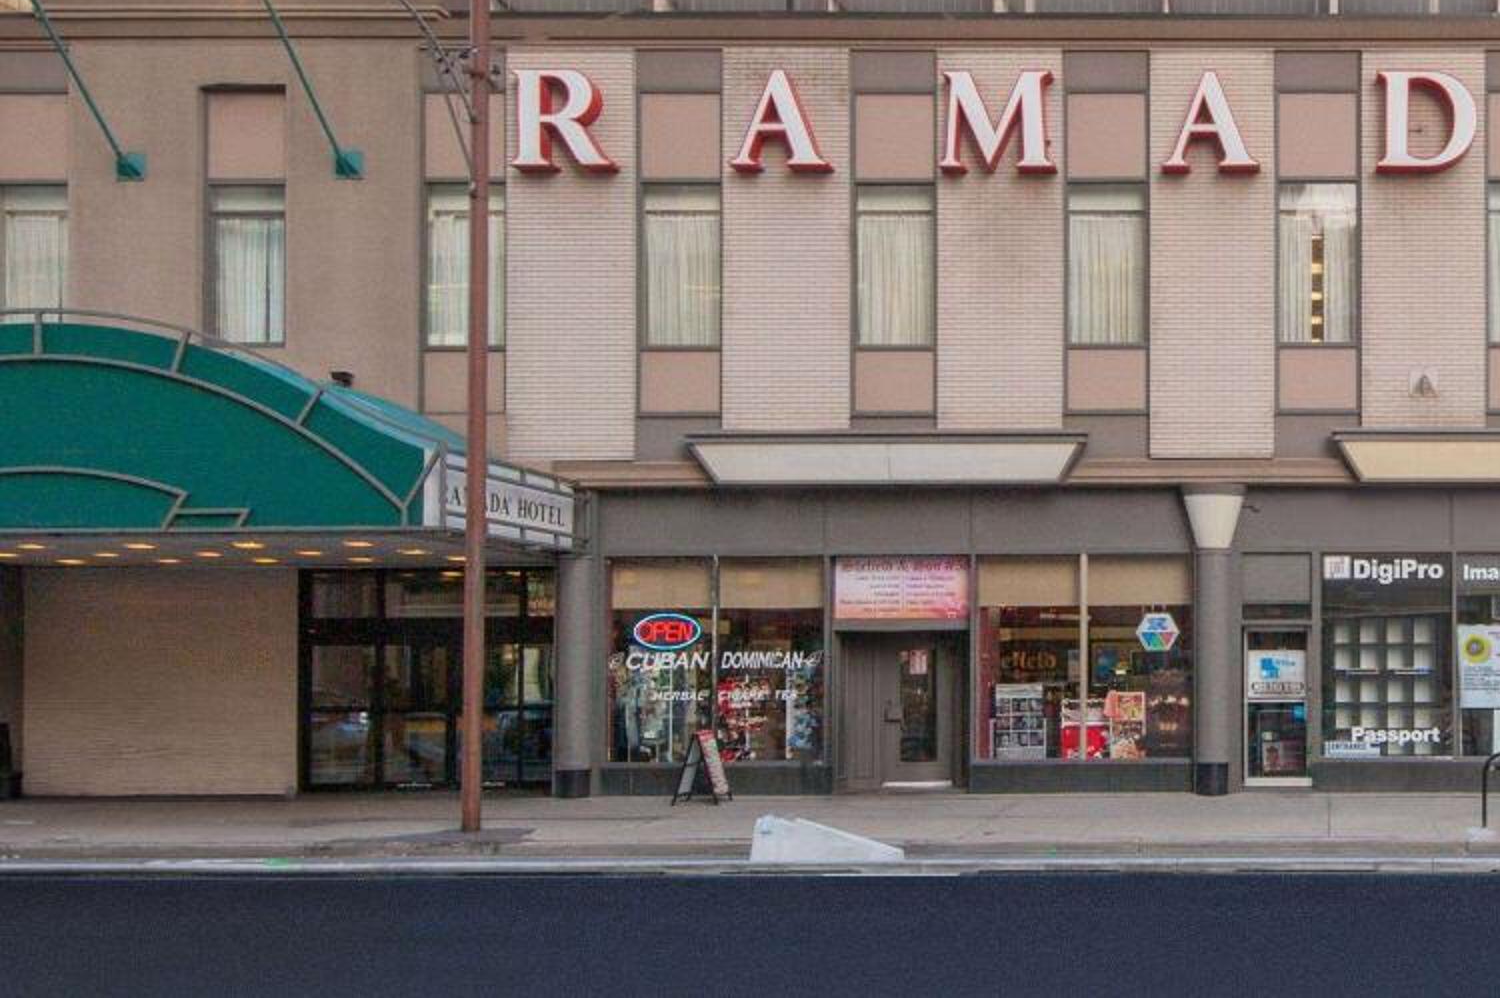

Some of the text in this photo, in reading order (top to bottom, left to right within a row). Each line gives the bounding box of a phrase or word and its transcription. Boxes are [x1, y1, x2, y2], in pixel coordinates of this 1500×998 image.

[517, 497, 565, 527] HOTEL
[1353, 559, 1444, 584] DigiPro
[638, 621, 694, 643] OPEN
[625, 652, 806, 670] CUBAN DOMINICAN
[1351, 726, 1441, 747] Passport
